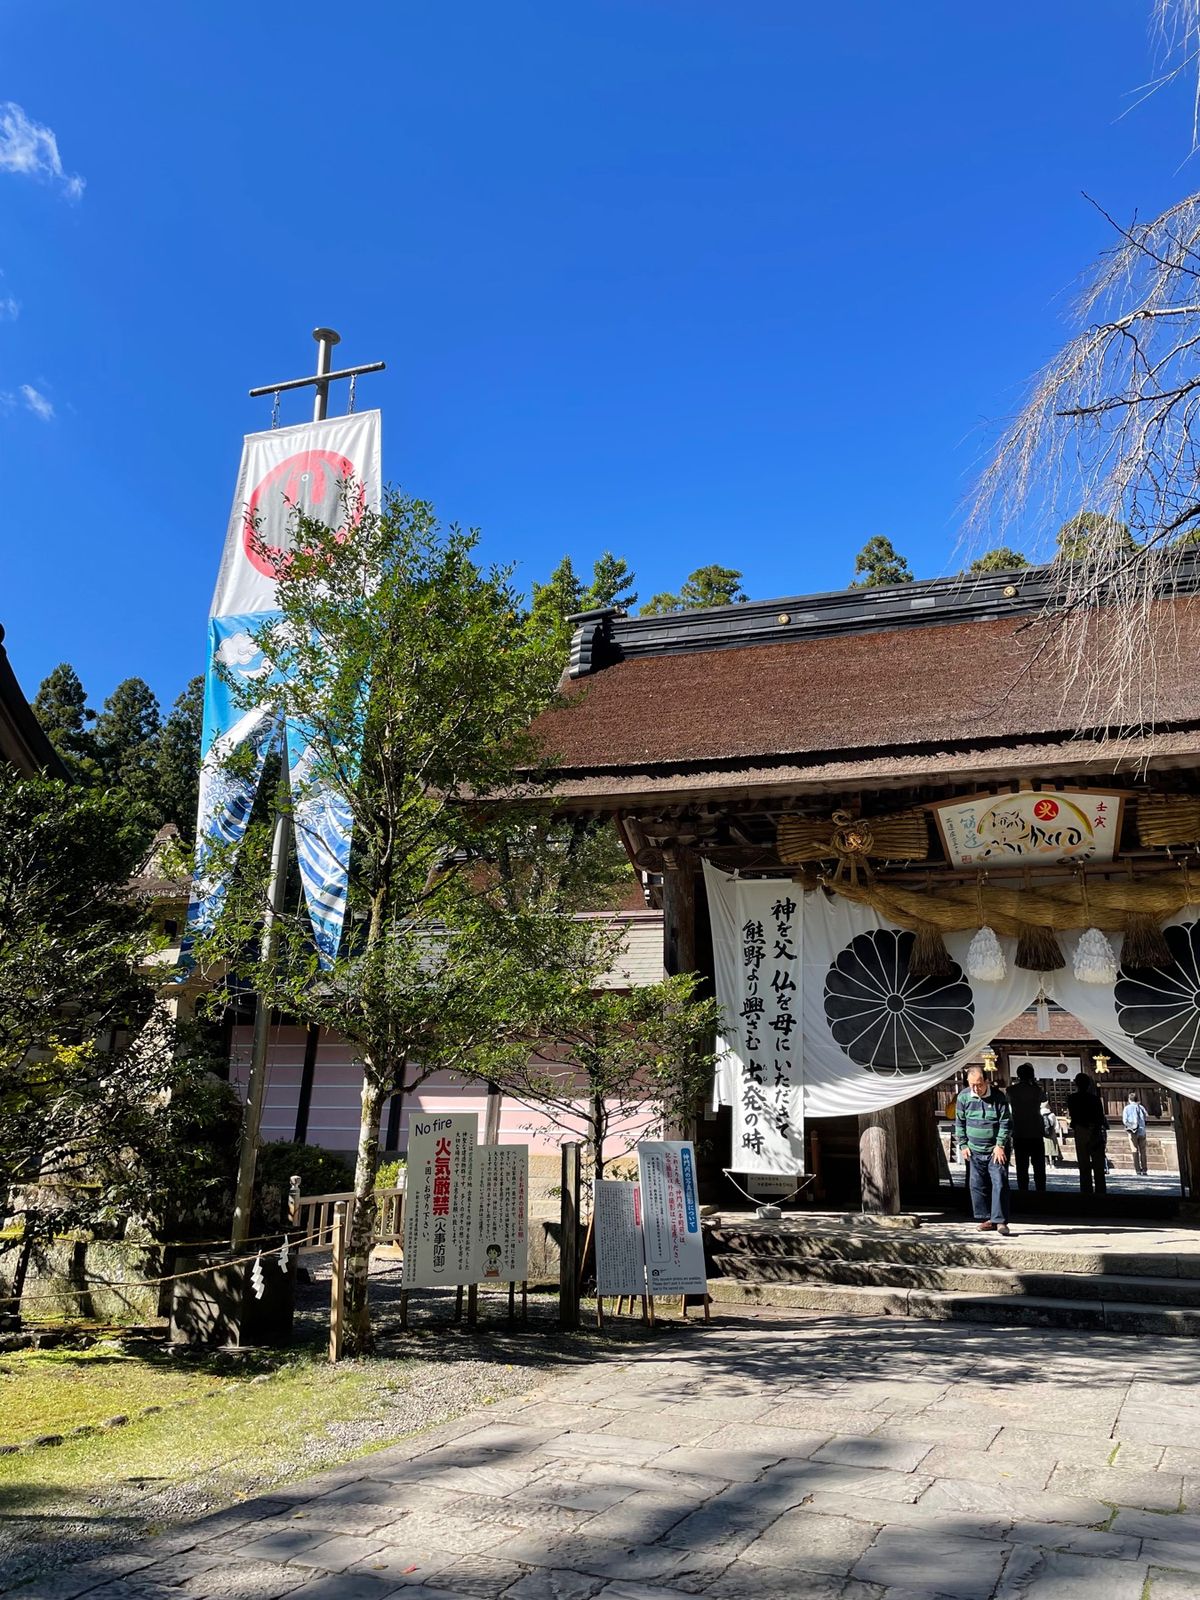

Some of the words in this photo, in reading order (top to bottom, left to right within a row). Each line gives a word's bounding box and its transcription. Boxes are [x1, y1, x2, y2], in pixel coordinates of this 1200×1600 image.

[1094, 800, 1108, 828] 壬寅
[415, 1123, 431, 1137] No
[432, 1118, 453, 1132] fire
[740, 1058, 767, 1156] 出発の時
[682, 1153, 696, 1228] 神門内の写真影について
